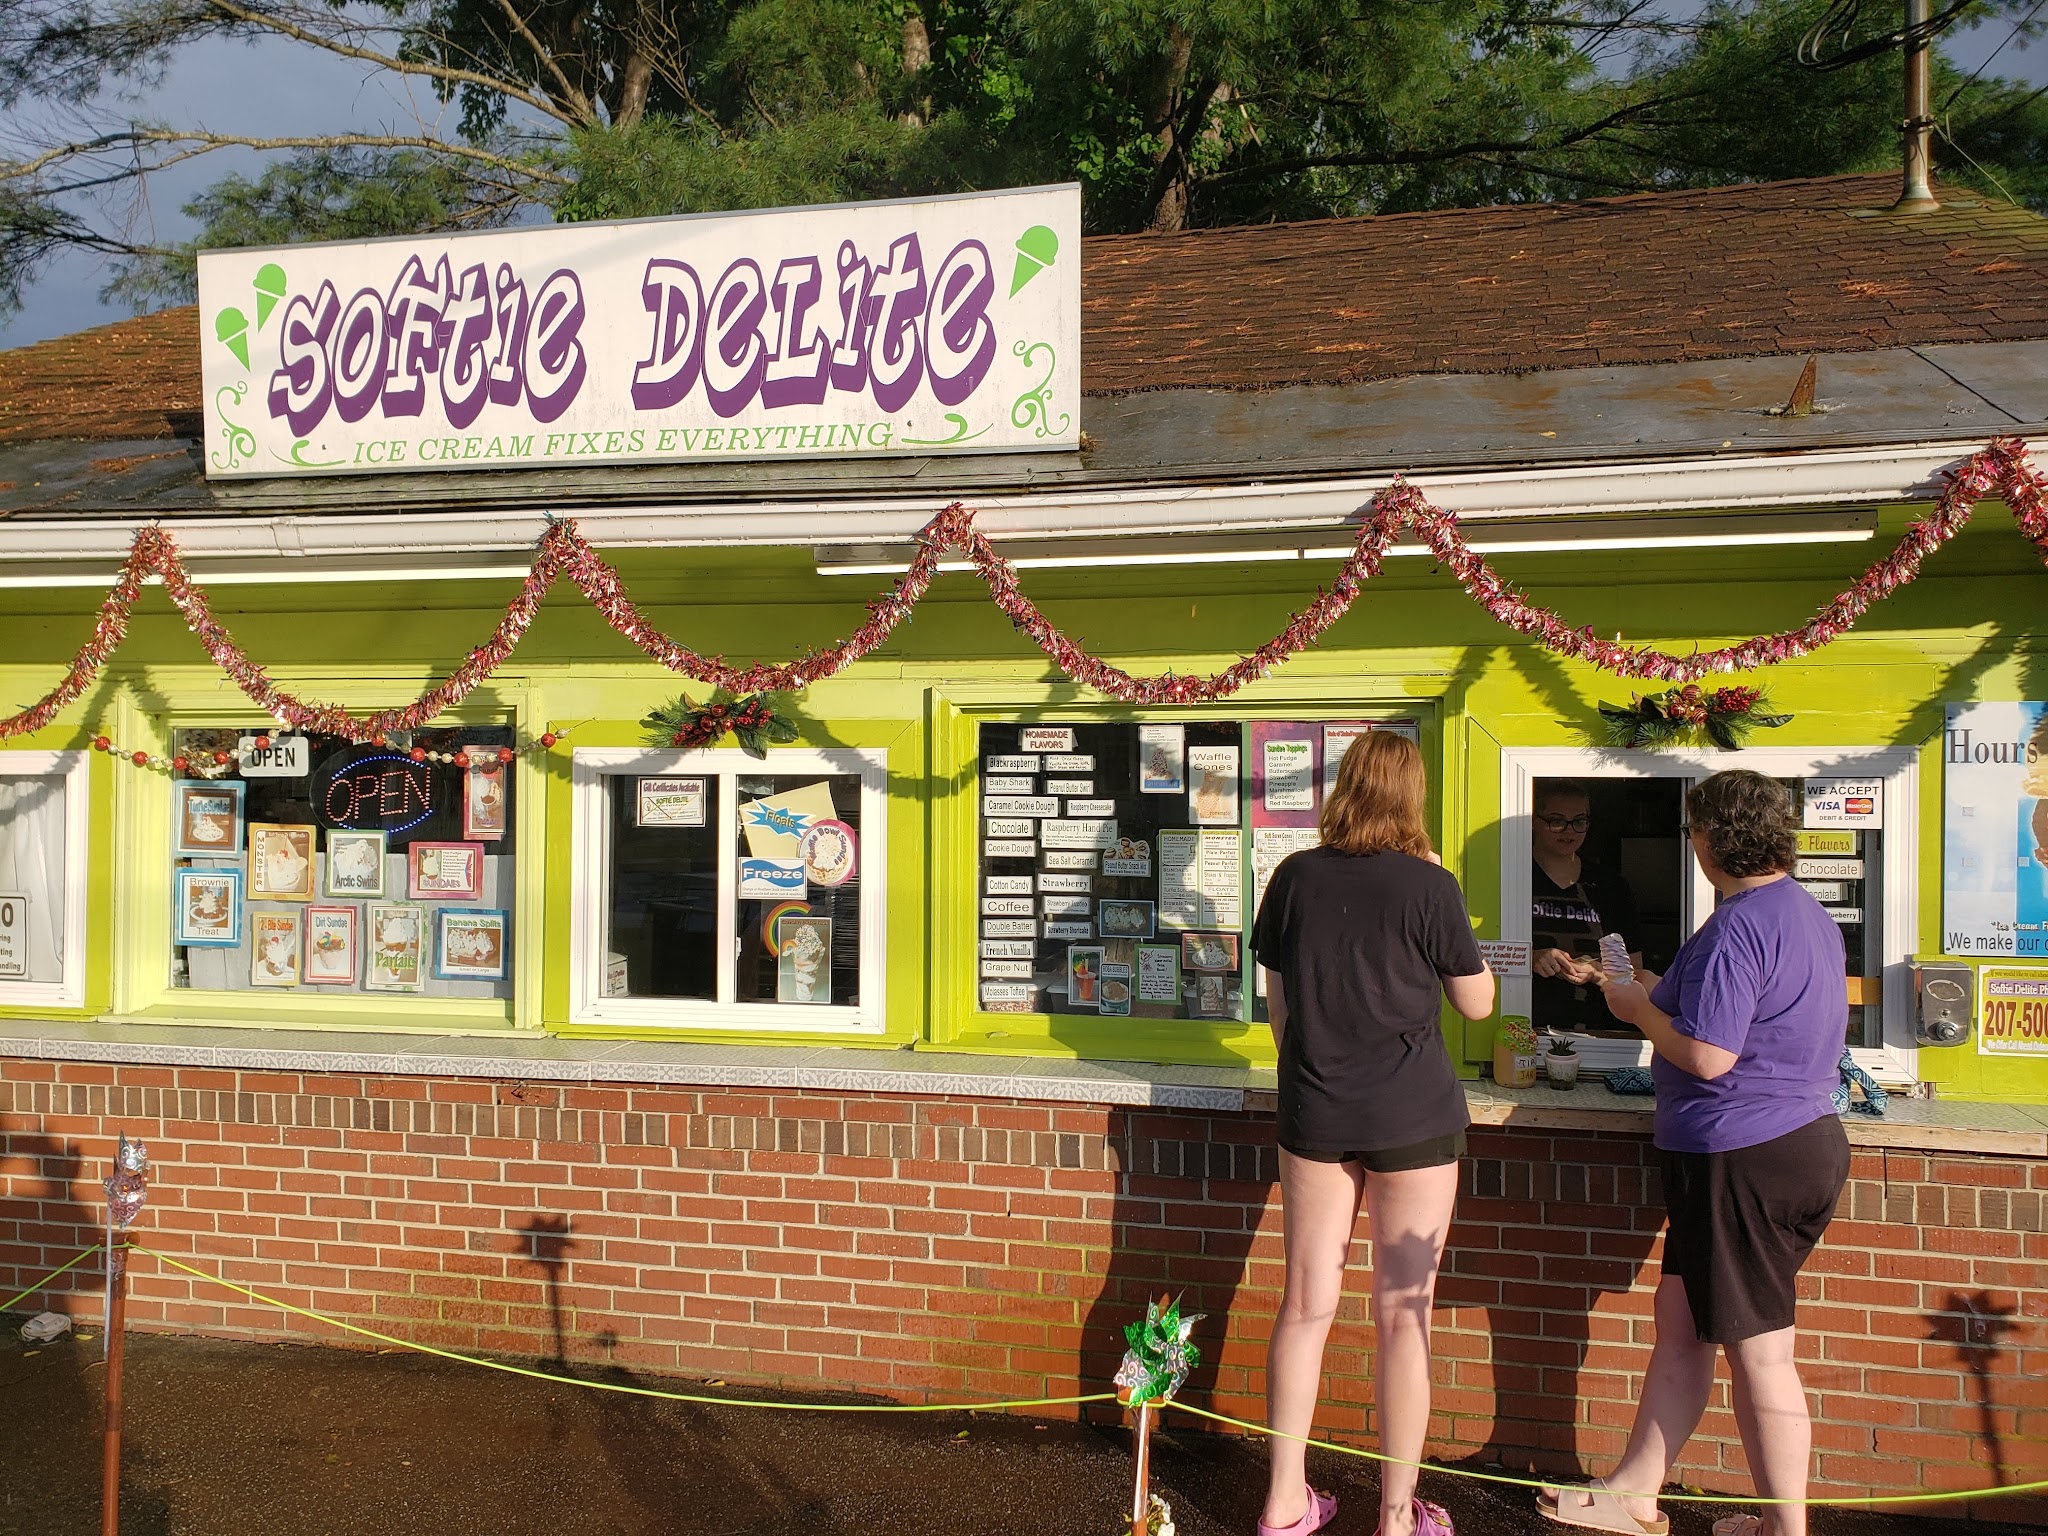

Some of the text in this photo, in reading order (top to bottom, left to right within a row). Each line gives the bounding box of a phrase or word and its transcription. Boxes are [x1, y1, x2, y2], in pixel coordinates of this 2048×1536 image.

[353, 421, 893, 464] ICE CREAM FIXES EVERYTHING
[1025, 730, 1069, 739] HOMEMADE
[1030, 740, 1064, 749] FLAVORS
[1946, 728, 2039, 765] Hours
[251, 748, 296, 767] OPEN
[1194, 753, 1232, 761] Waffle
[989, 757, 1037, 770] Blackraspberry
[1193, 763, 1233, 771] Cones
[989, 778, 1030, 788] Baby Shark
[326, 767, 432, 823] OPEN
[1807, 786, 1880, 795] WE ACCEPT
[989, 800, 1055, 813] Caramel Cookie Dough
[1070, 802, 1090, 812] Raspberry
[1814, 801, 1841, 811] VISA
[766, 811, 796, 829] Floats
[816, 827, 840, 837] Bowl
[991, 821, 1029, 834] Chocolate
[1046, 821, 1113, 835] Raspberry Hand Pie
[988, 843, 1032, 855] Cookie Dough
[1808, 836, 1850, 852] Flavors
[256, 836, 265, 886] MONSTER
[1048, 856, 1094, 866] Sea Salt Caramel
[743, 867, 803, 879] Freeze
[1800, 862, 1858, 875] Chocolate
[190, 878, 230, 887] Brownie
[335, 874, 378, 888] Arctic Swirls
[989, 880, 1030, 892] Cotton Candy
[1042, 878, 1089, 891] Strawberry
[987, 901, 1030, 912] Coffee
[276, 919, 293, 932] Sundae
[315, 916, 348, 929] Dirt Sundae
[446, 918, 502, 930] Banana Splits
[986, 921, 1033, 931] Double Batter
[196, 926, 219, 936] Treat
[1948, 931, 1972, 949] We
[1976, 933, 2013, 950] make
[2017, 937, 2041, 951] our
[985, 944, 1031, 956] French Vanilla
[375, 951, 417, 970] Parfaits
[985, 963, 1029, 975] Grape Nut
[985, 986, 1026, 997] Molasses Toffee
[1990, 983, 2013, 994] Softie
[2014, 983, 2038, 995] Delite
[1519, 1058, 1535, 1068] TIP
[1520, 1070, 1534, 1080] JAR
